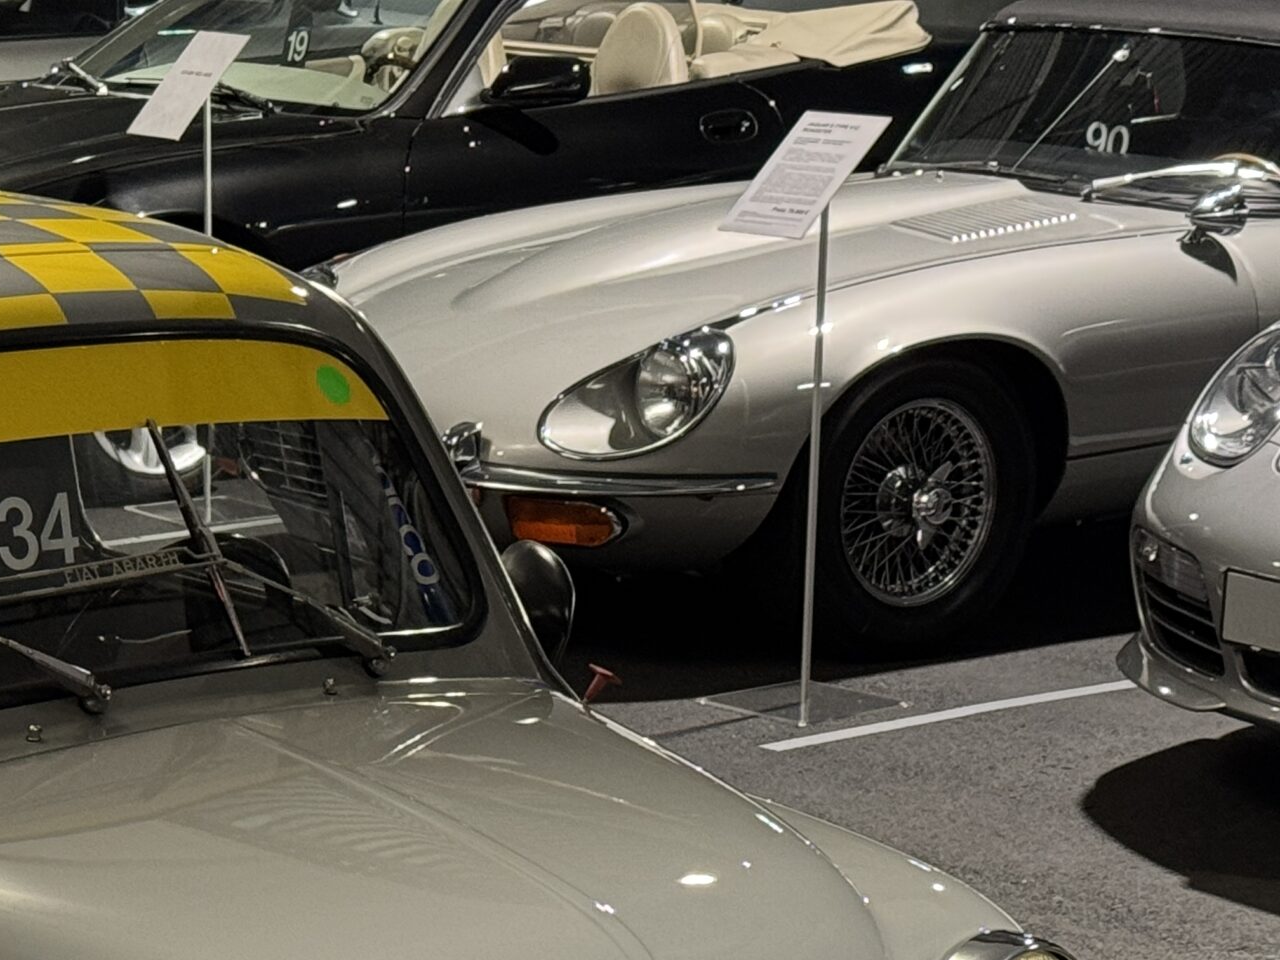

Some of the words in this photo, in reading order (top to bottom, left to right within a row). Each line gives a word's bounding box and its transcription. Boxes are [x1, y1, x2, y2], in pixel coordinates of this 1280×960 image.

[287, 30, 310, 63] 19
[1086, 121, 1130, 155] 90
[63, 564, 101, 584] FIAT
